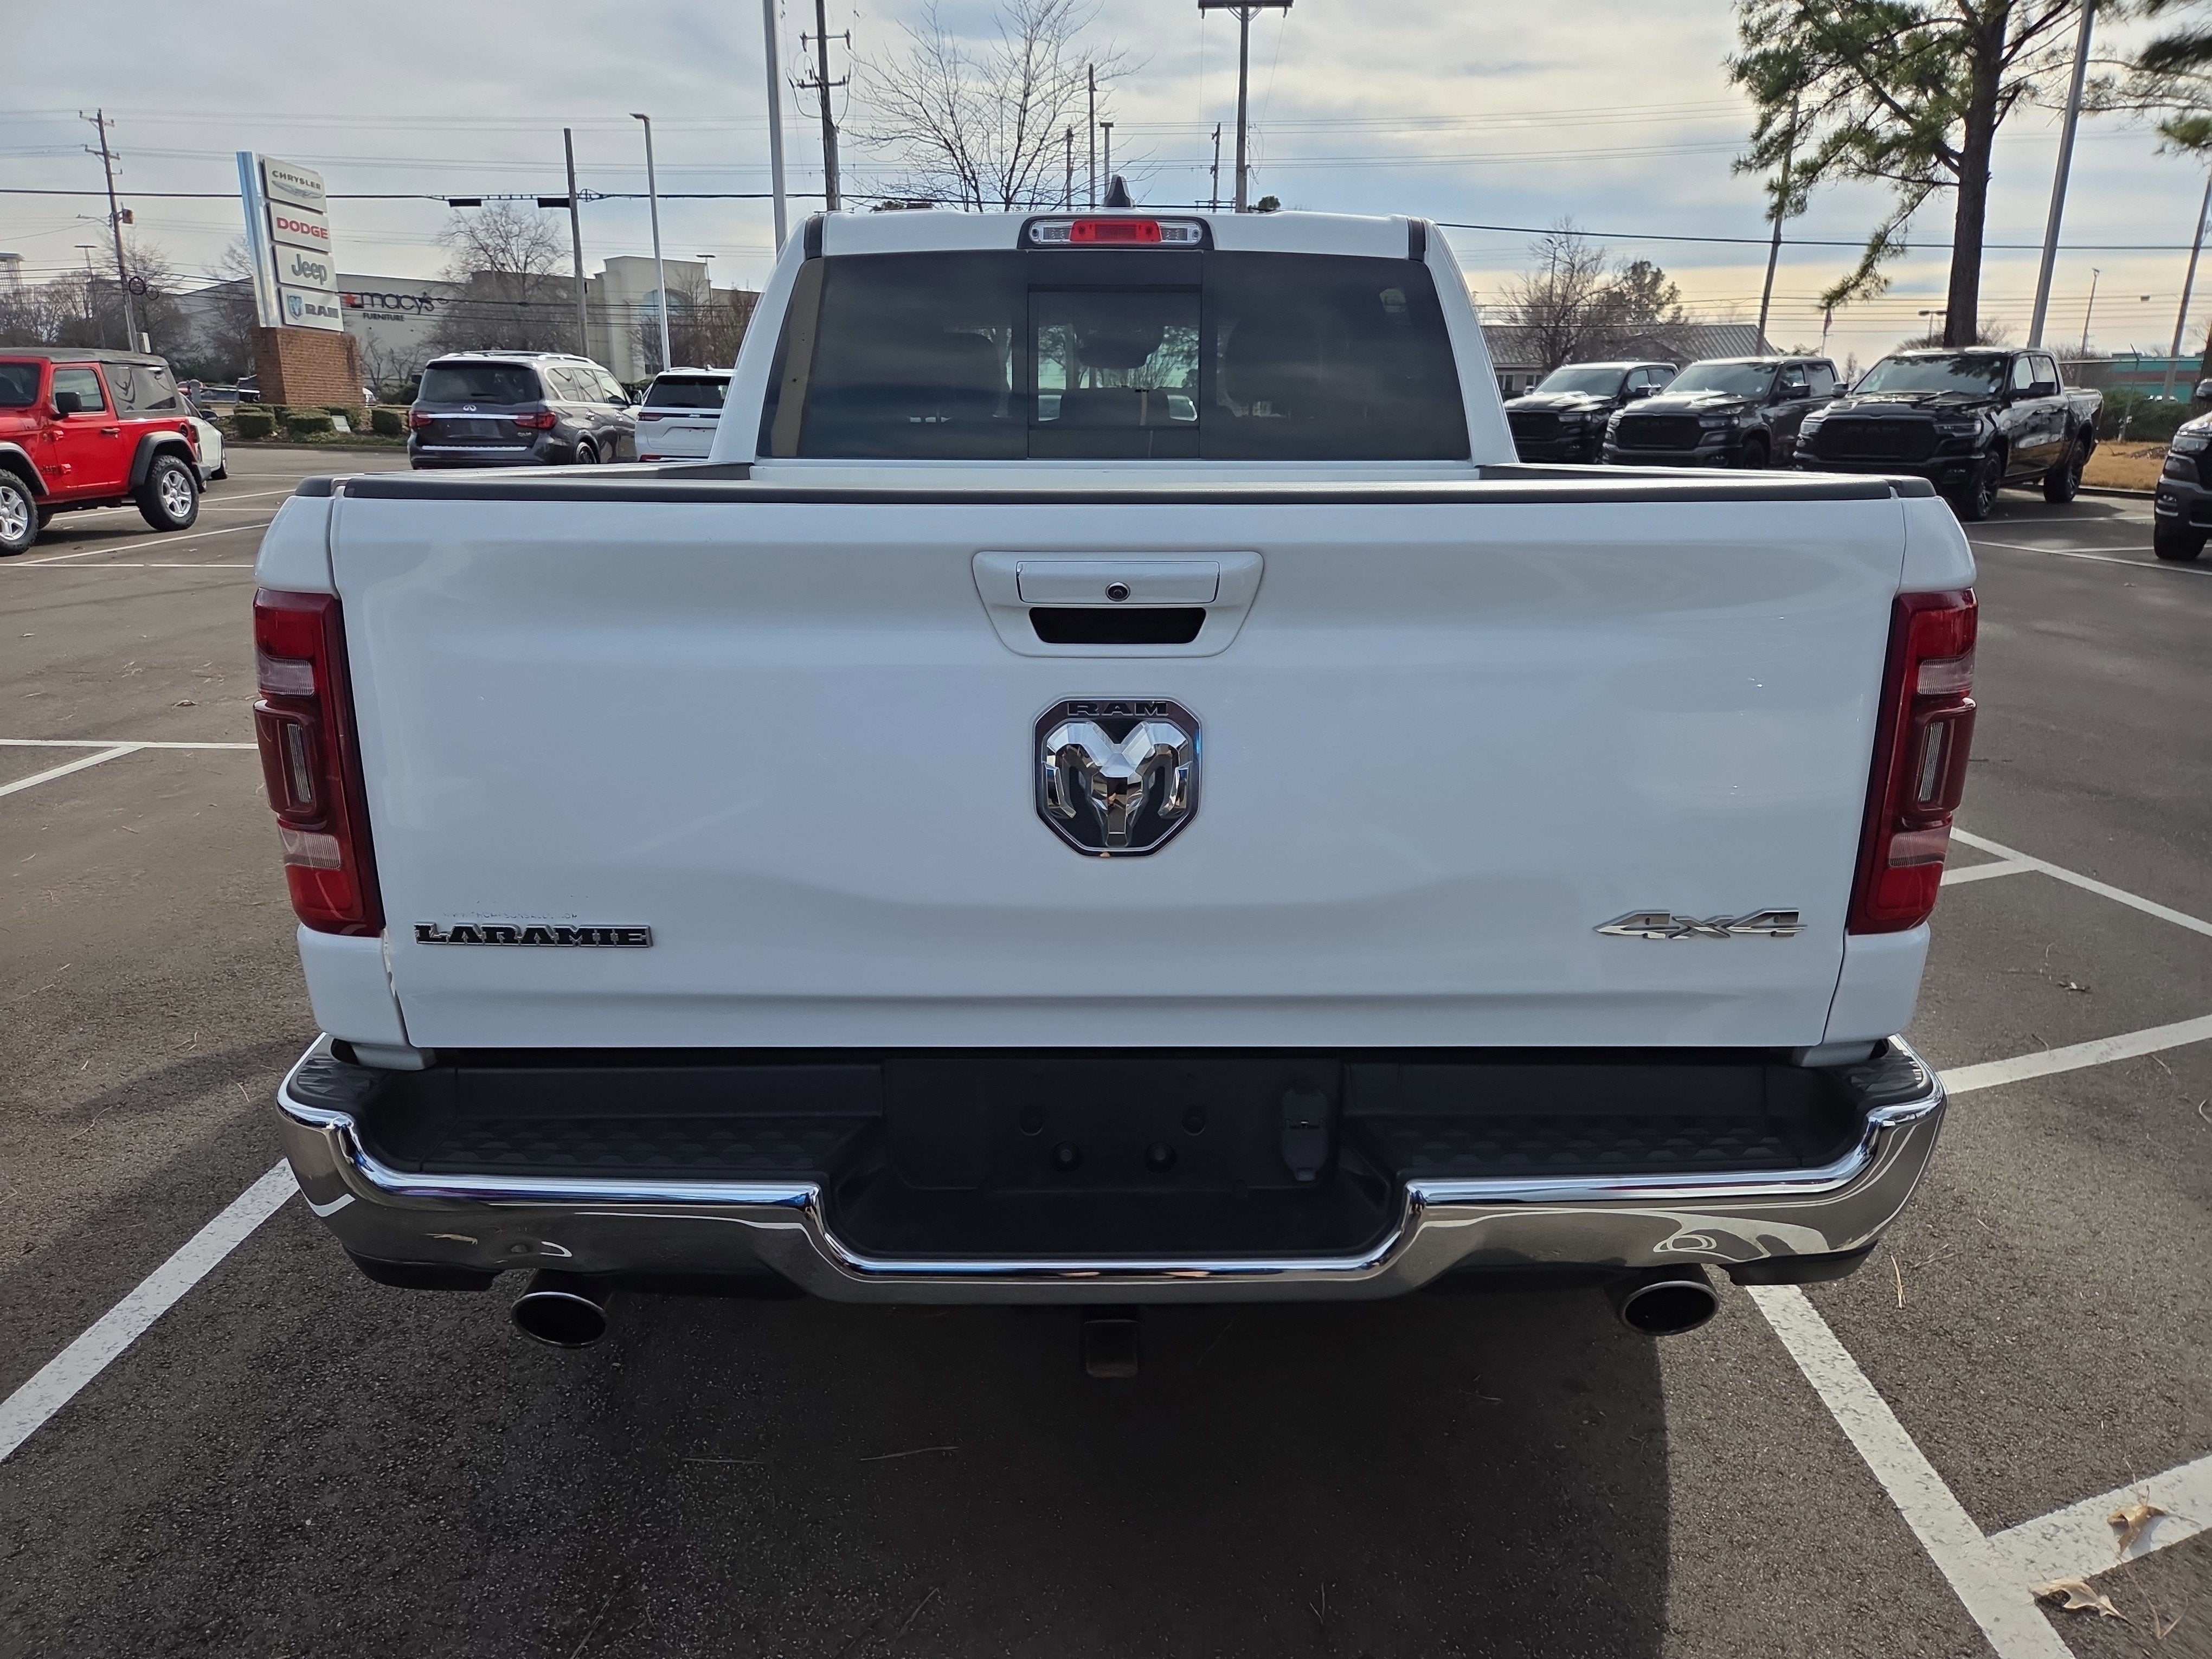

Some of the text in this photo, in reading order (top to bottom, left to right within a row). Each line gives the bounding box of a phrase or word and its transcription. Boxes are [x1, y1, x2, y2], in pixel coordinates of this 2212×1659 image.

[272, 170, 321, 190] CHRYSLER
[276, 217, 329, 239] DODGE
[291, 253, 328, 285] Jeep
[305, 303, 339, 319] RAM
[363, 312, 406, 321] FURNITURE
[1067, 702, 1169, 716] RAM
[413, 922, 653, 948] LARAMIE
